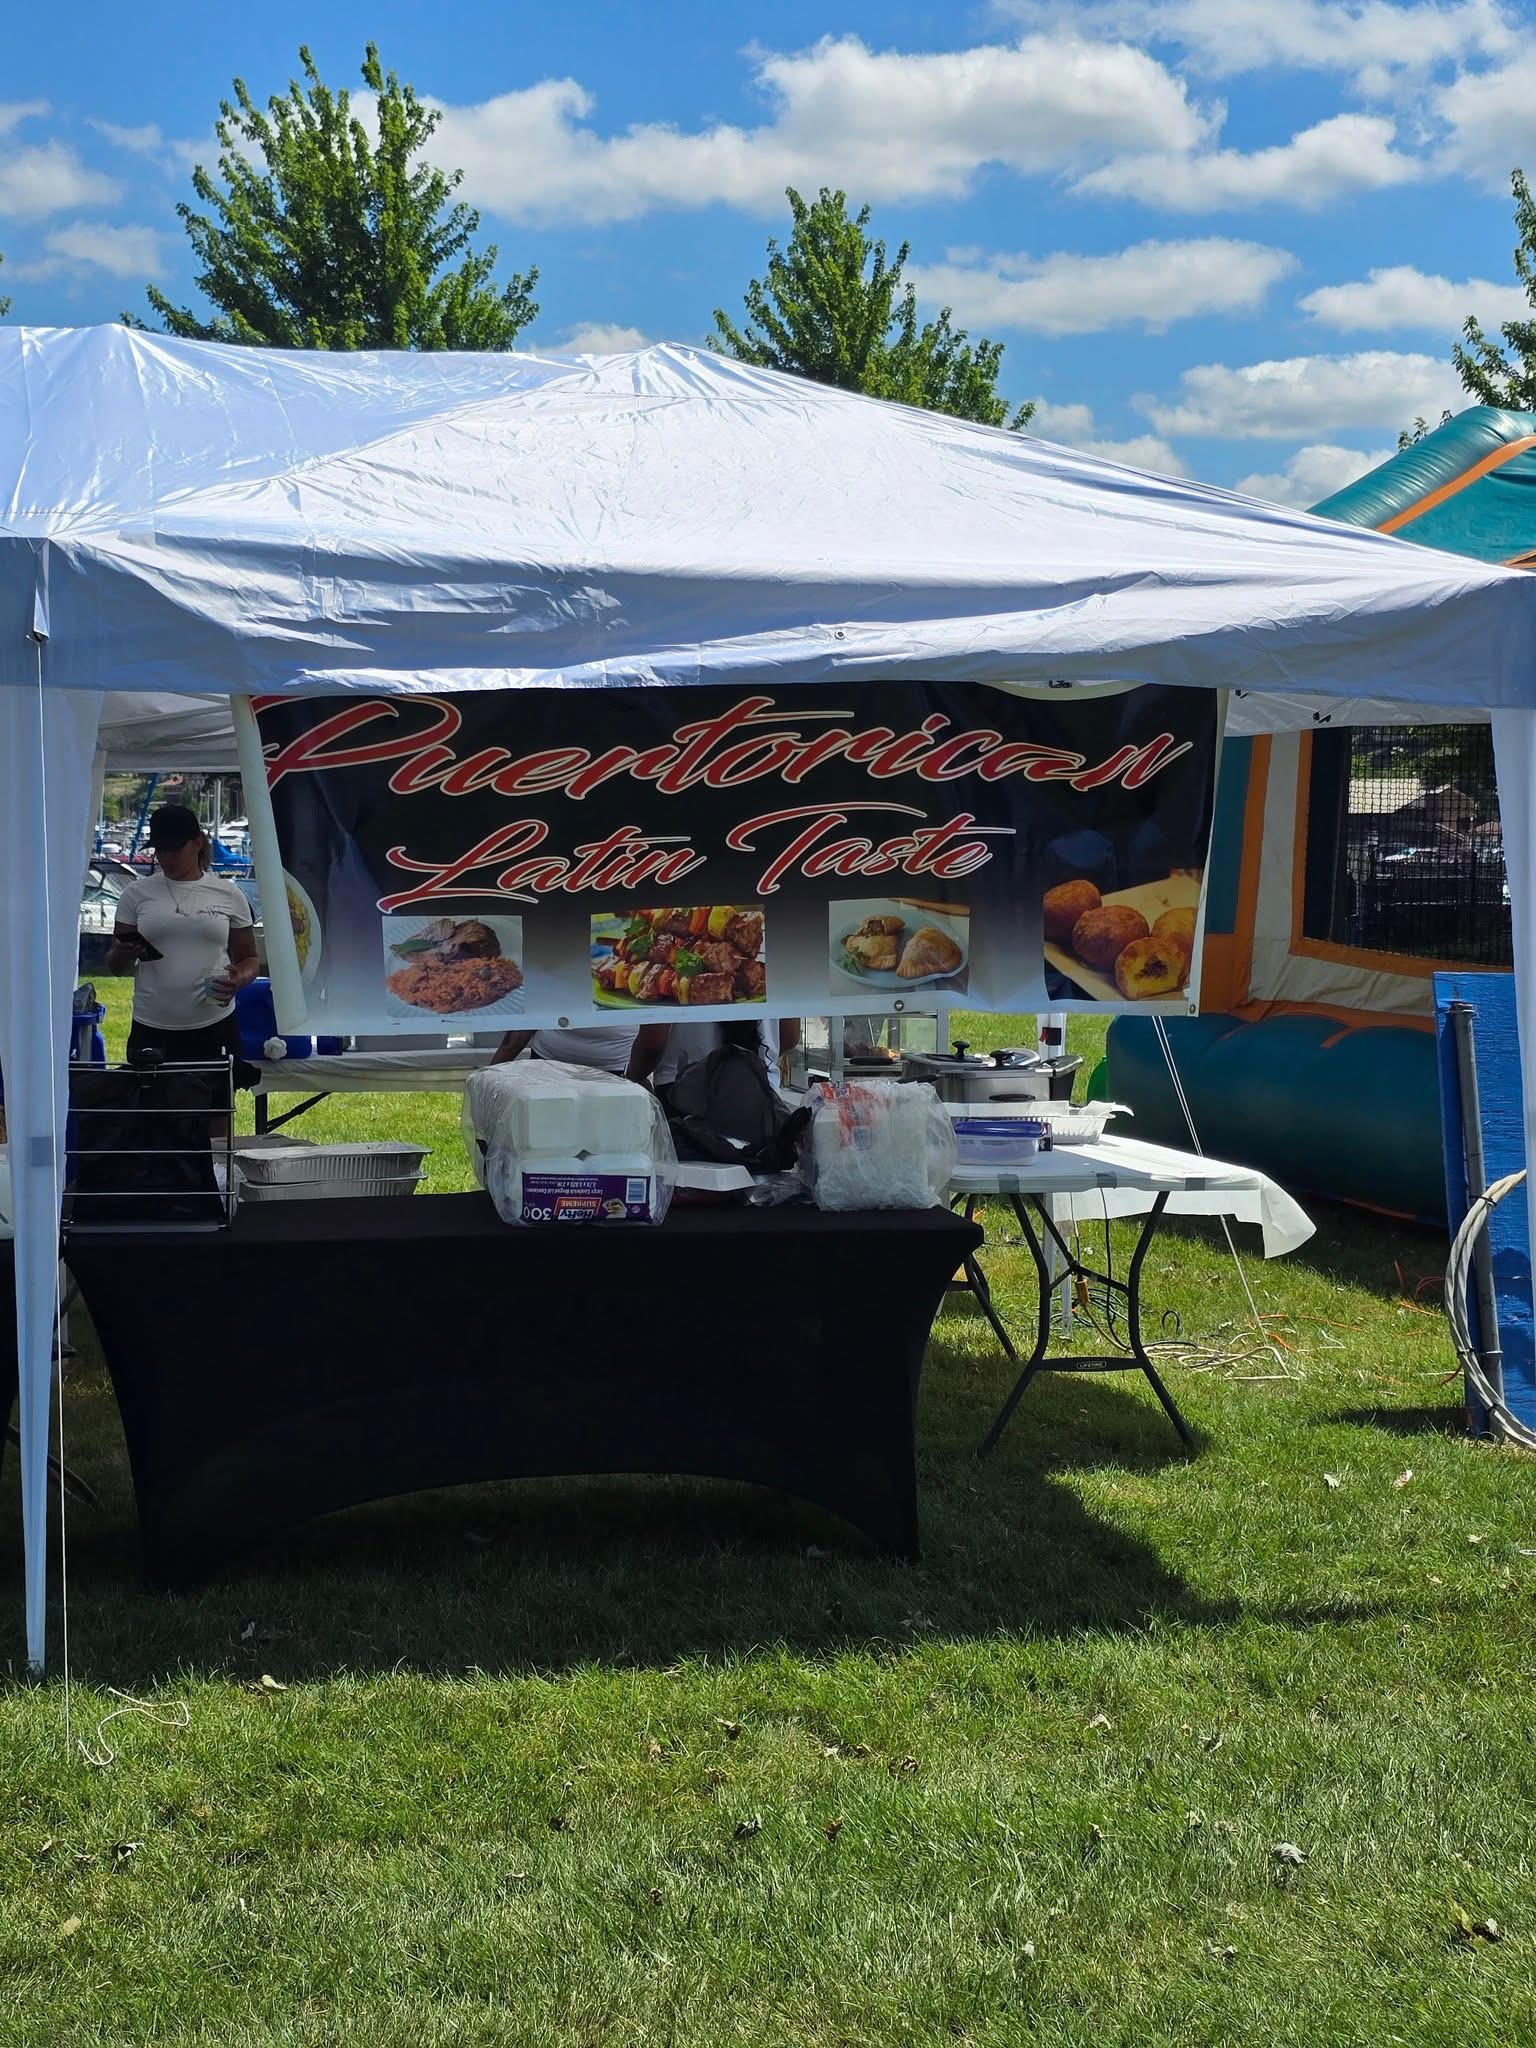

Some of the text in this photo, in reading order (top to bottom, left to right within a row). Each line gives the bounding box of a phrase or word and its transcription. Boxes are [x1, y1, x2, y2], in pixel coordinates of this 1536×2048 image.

[249, 694, 1194, 800] Puertorican
[377, 801, 1017, 914] Latin Taste
[523, 1207, 552, 1220] 300
[559, 1208, 593, 1219] Hefty
